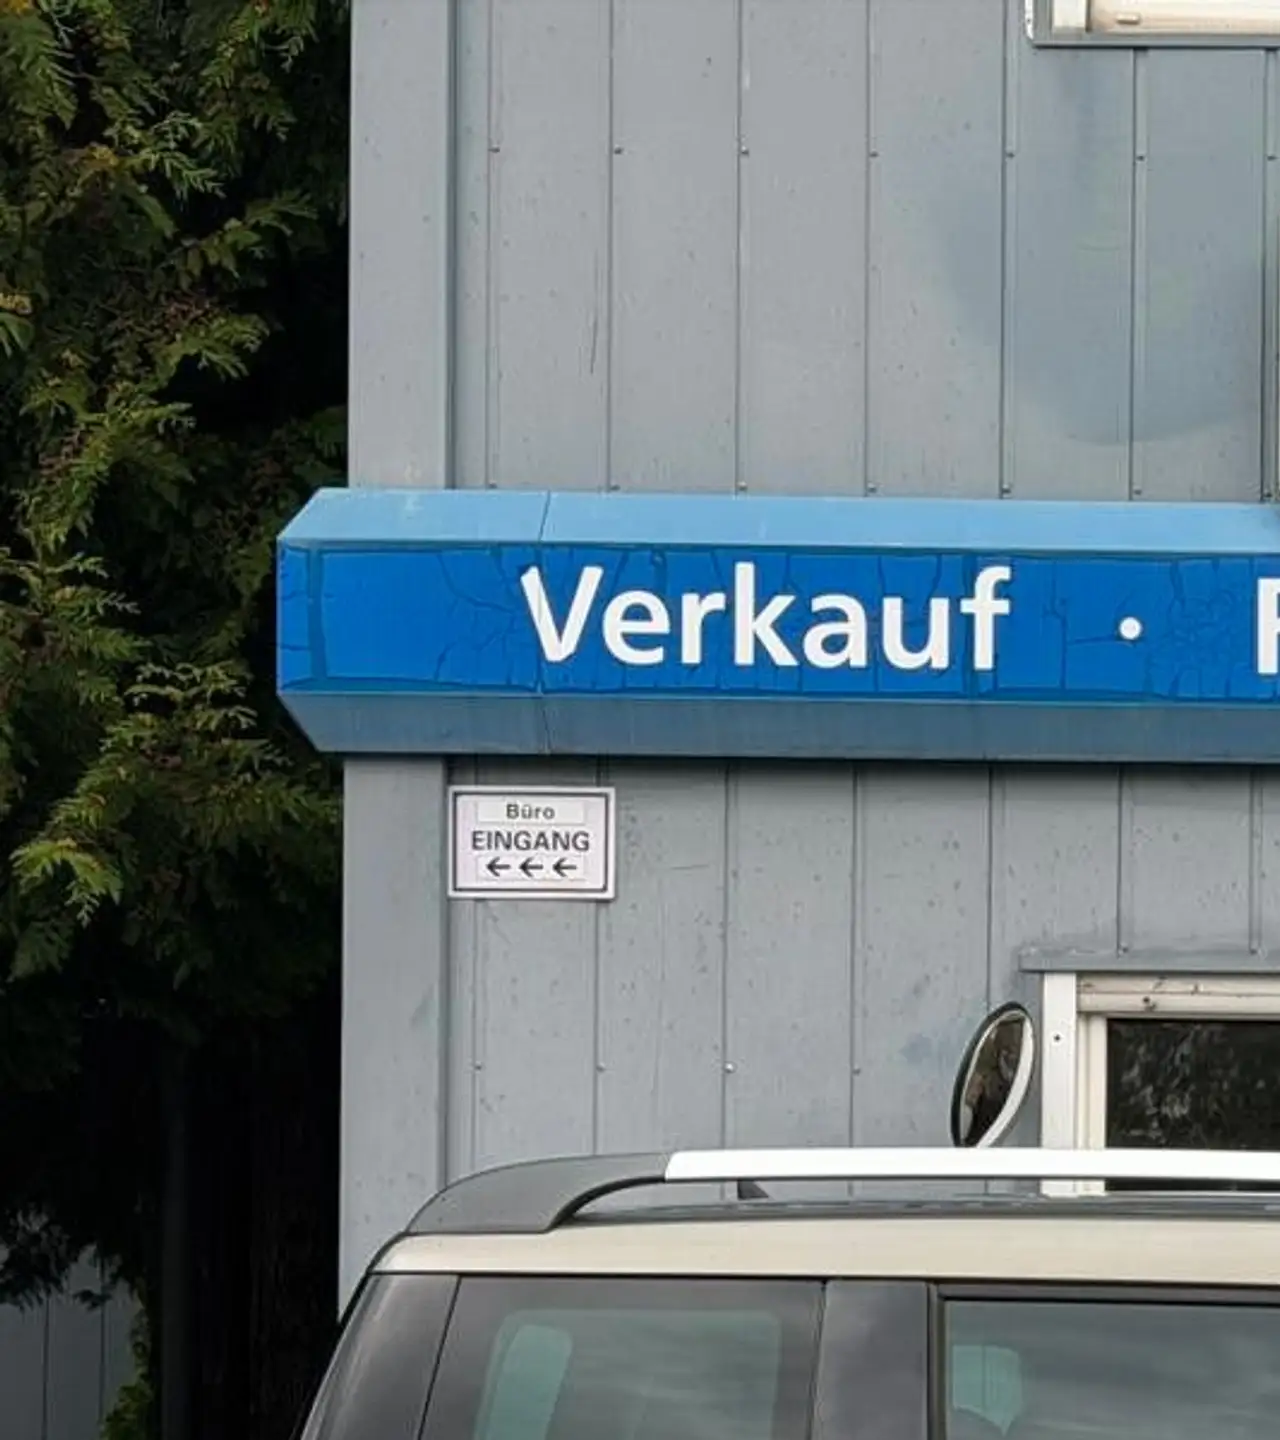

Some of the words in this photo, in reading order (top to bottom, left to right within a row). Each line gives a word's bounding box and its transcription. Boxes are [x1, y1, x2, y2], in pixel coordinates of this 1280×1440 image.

[520, 562, 1012, 671] Verkauf
[506, 803, 556, 820] Büro
[471, 829, 591, 852] EINGANG
